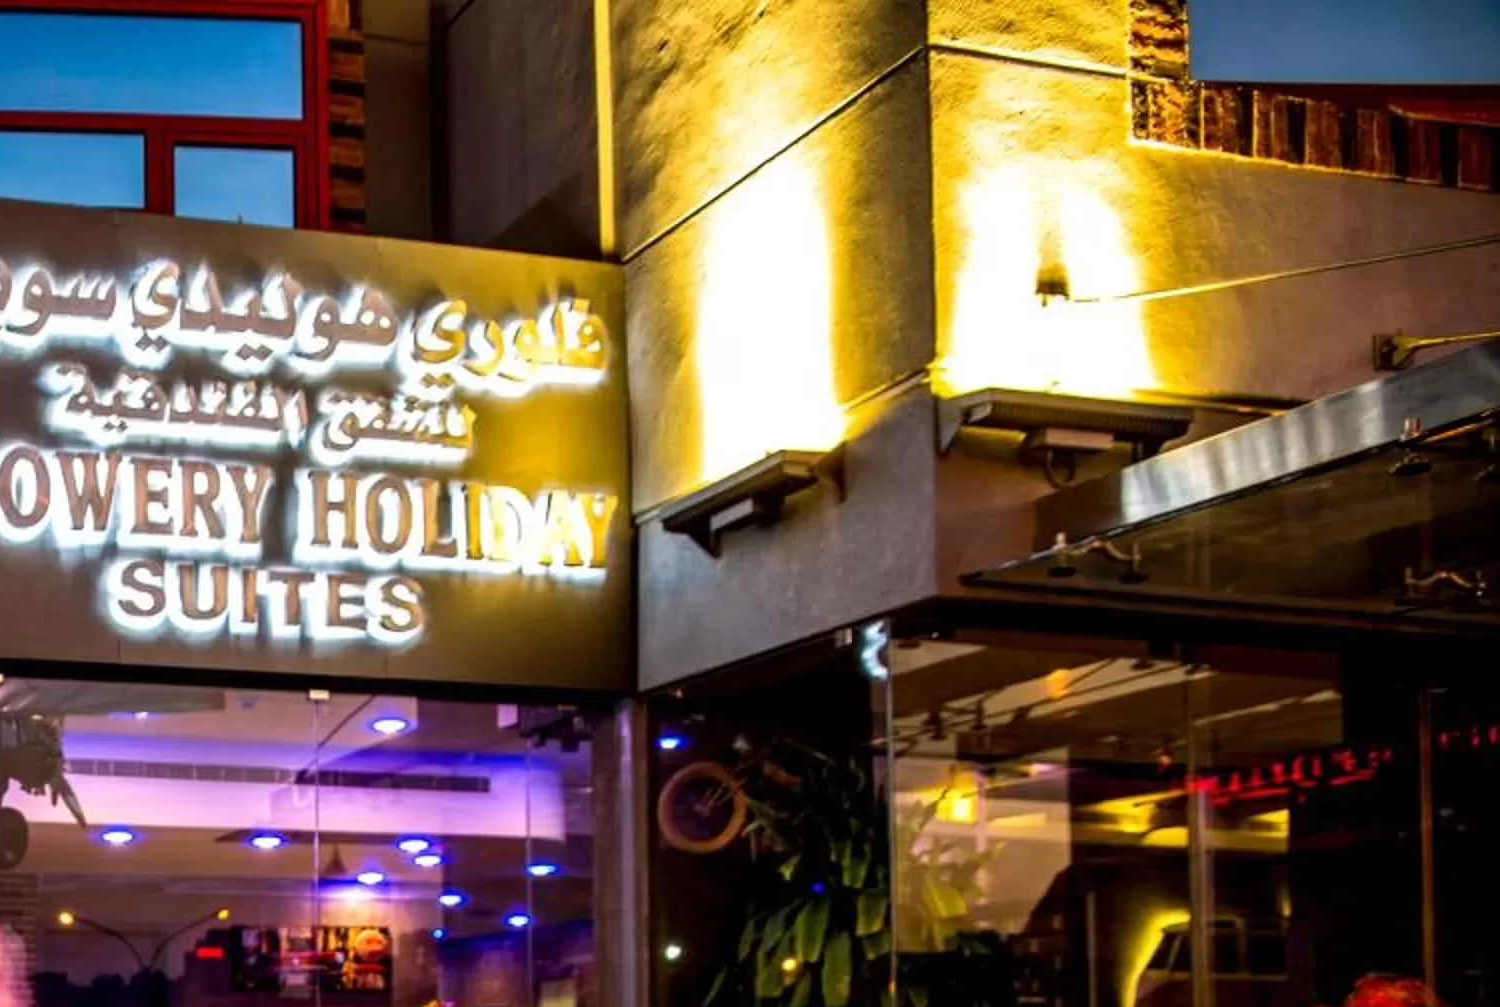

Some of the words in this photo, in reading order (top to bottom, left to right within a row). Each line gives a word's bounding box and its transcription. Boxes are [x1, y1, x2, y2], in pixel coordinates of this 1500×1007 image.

[412, 297, 609, 391] فلوري
[308, 470, 618, 568] HOLIDAY
[116, 559, 423, 633] SUITES
